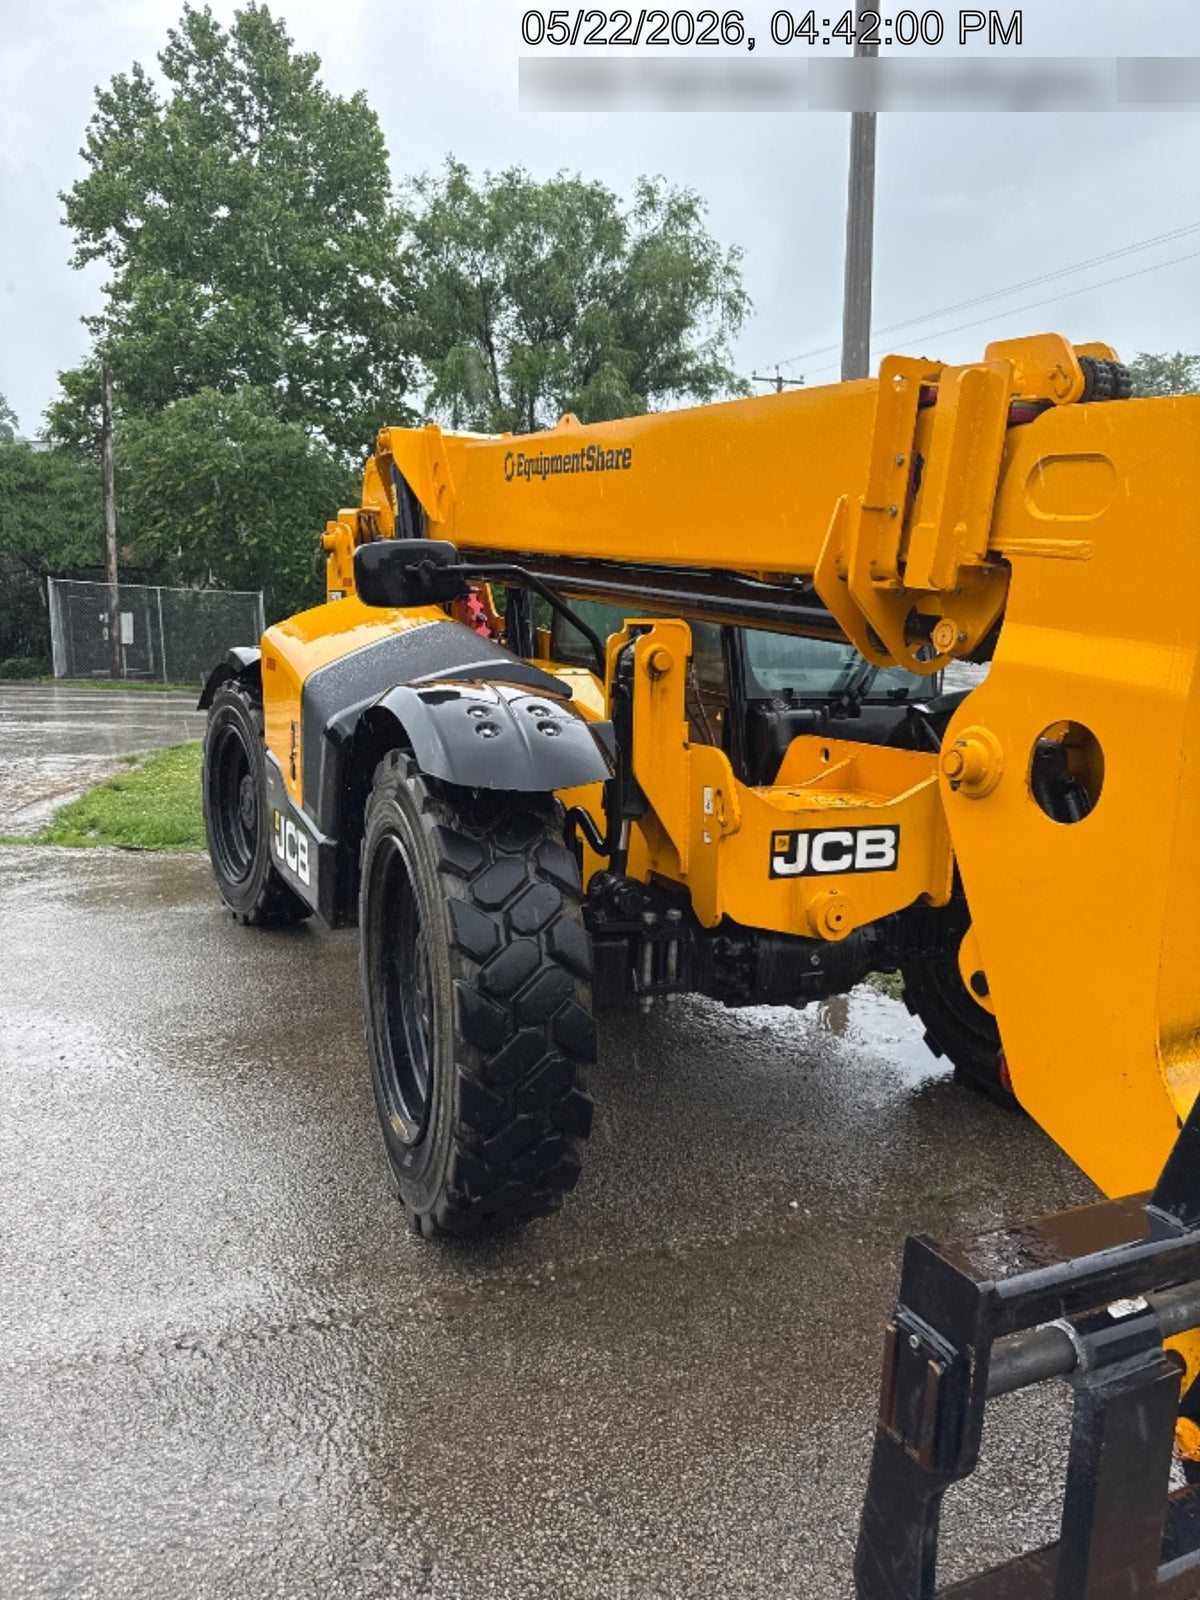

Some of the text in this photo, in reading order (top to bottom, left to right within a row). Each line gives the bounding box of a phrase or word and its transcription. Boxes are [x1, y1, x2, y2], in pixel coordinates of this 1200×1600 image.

[516, 444, 633, 482] EquipmentShare
[274, 815, 311, 887] JCB
[772, 829, 896, 875] JCB
